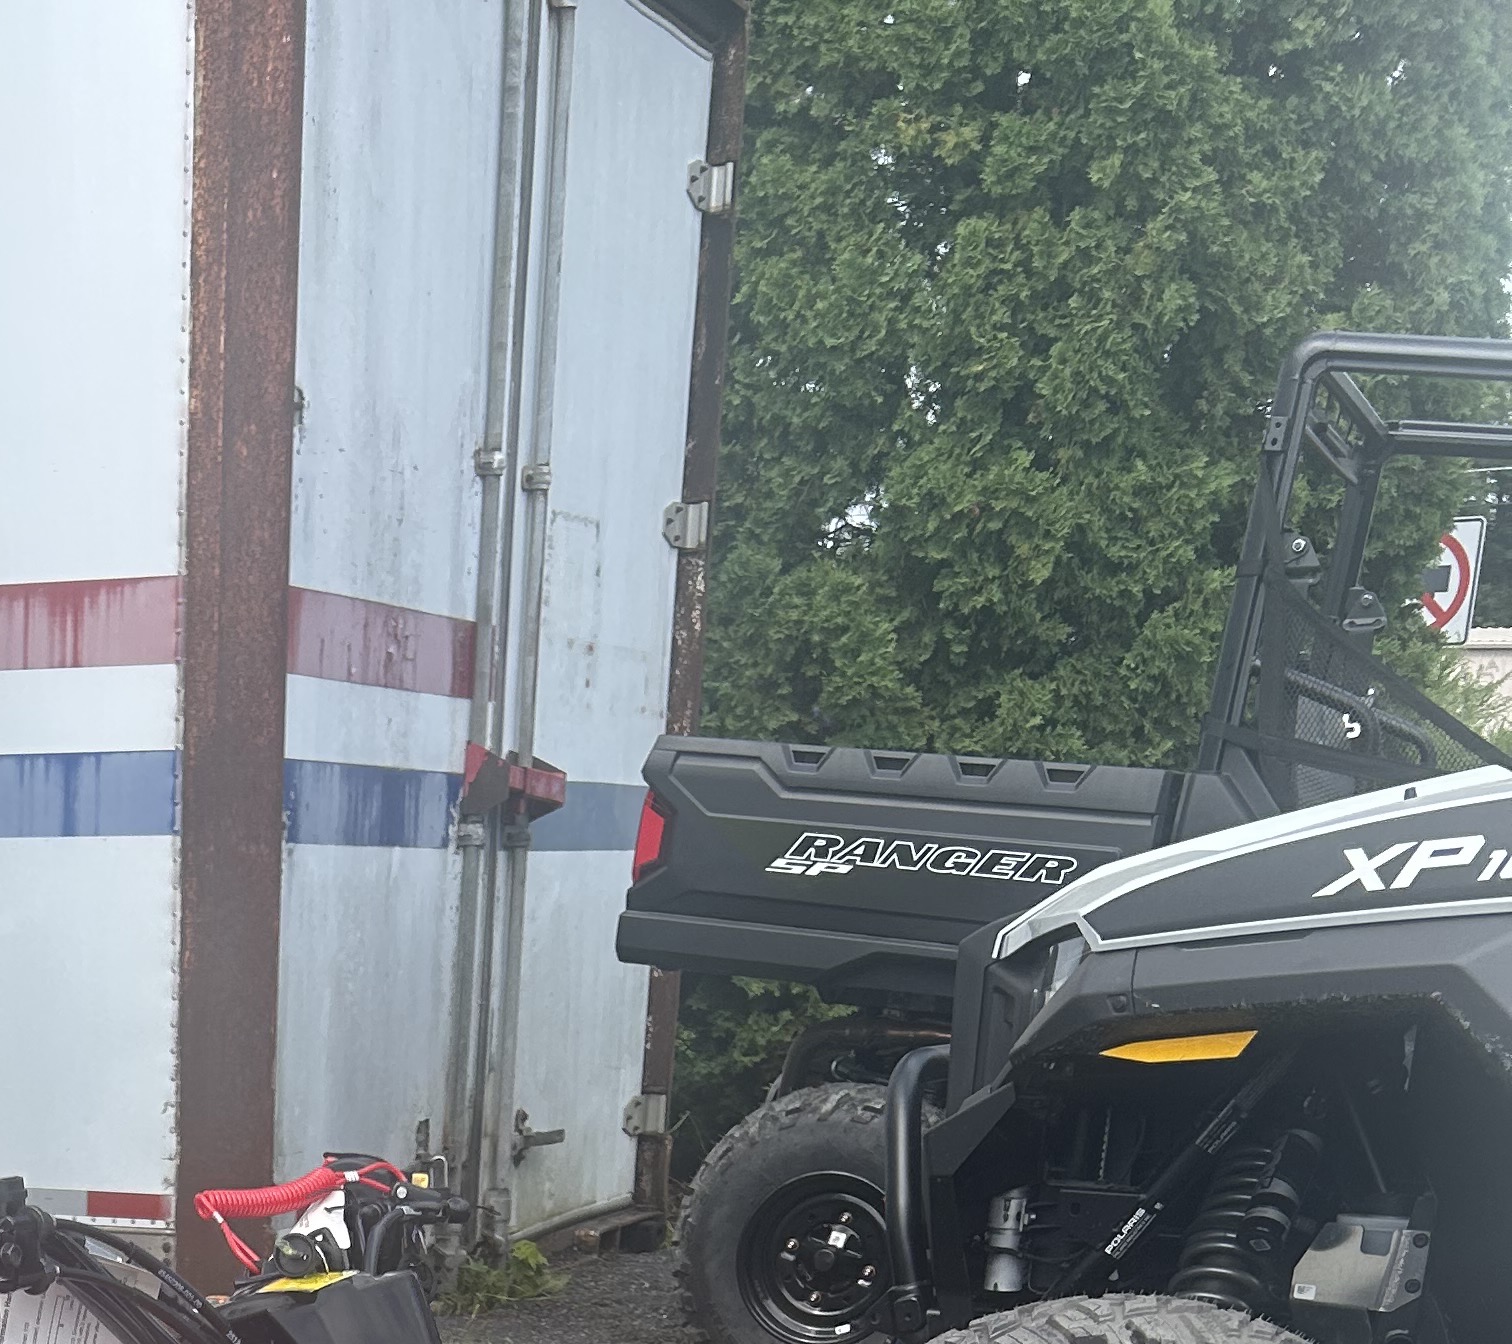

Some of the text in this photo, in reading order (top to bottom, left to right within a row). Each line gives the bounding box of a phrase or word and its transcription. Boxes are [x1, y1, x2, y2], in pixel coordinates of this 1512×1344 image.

[765, 856, 857, 877] SP
[786, 831, 1079, 885] RANGER
[1311, 834, 1486, 899] XP
[1104, 1207, 1146, 1255] POLARIS
